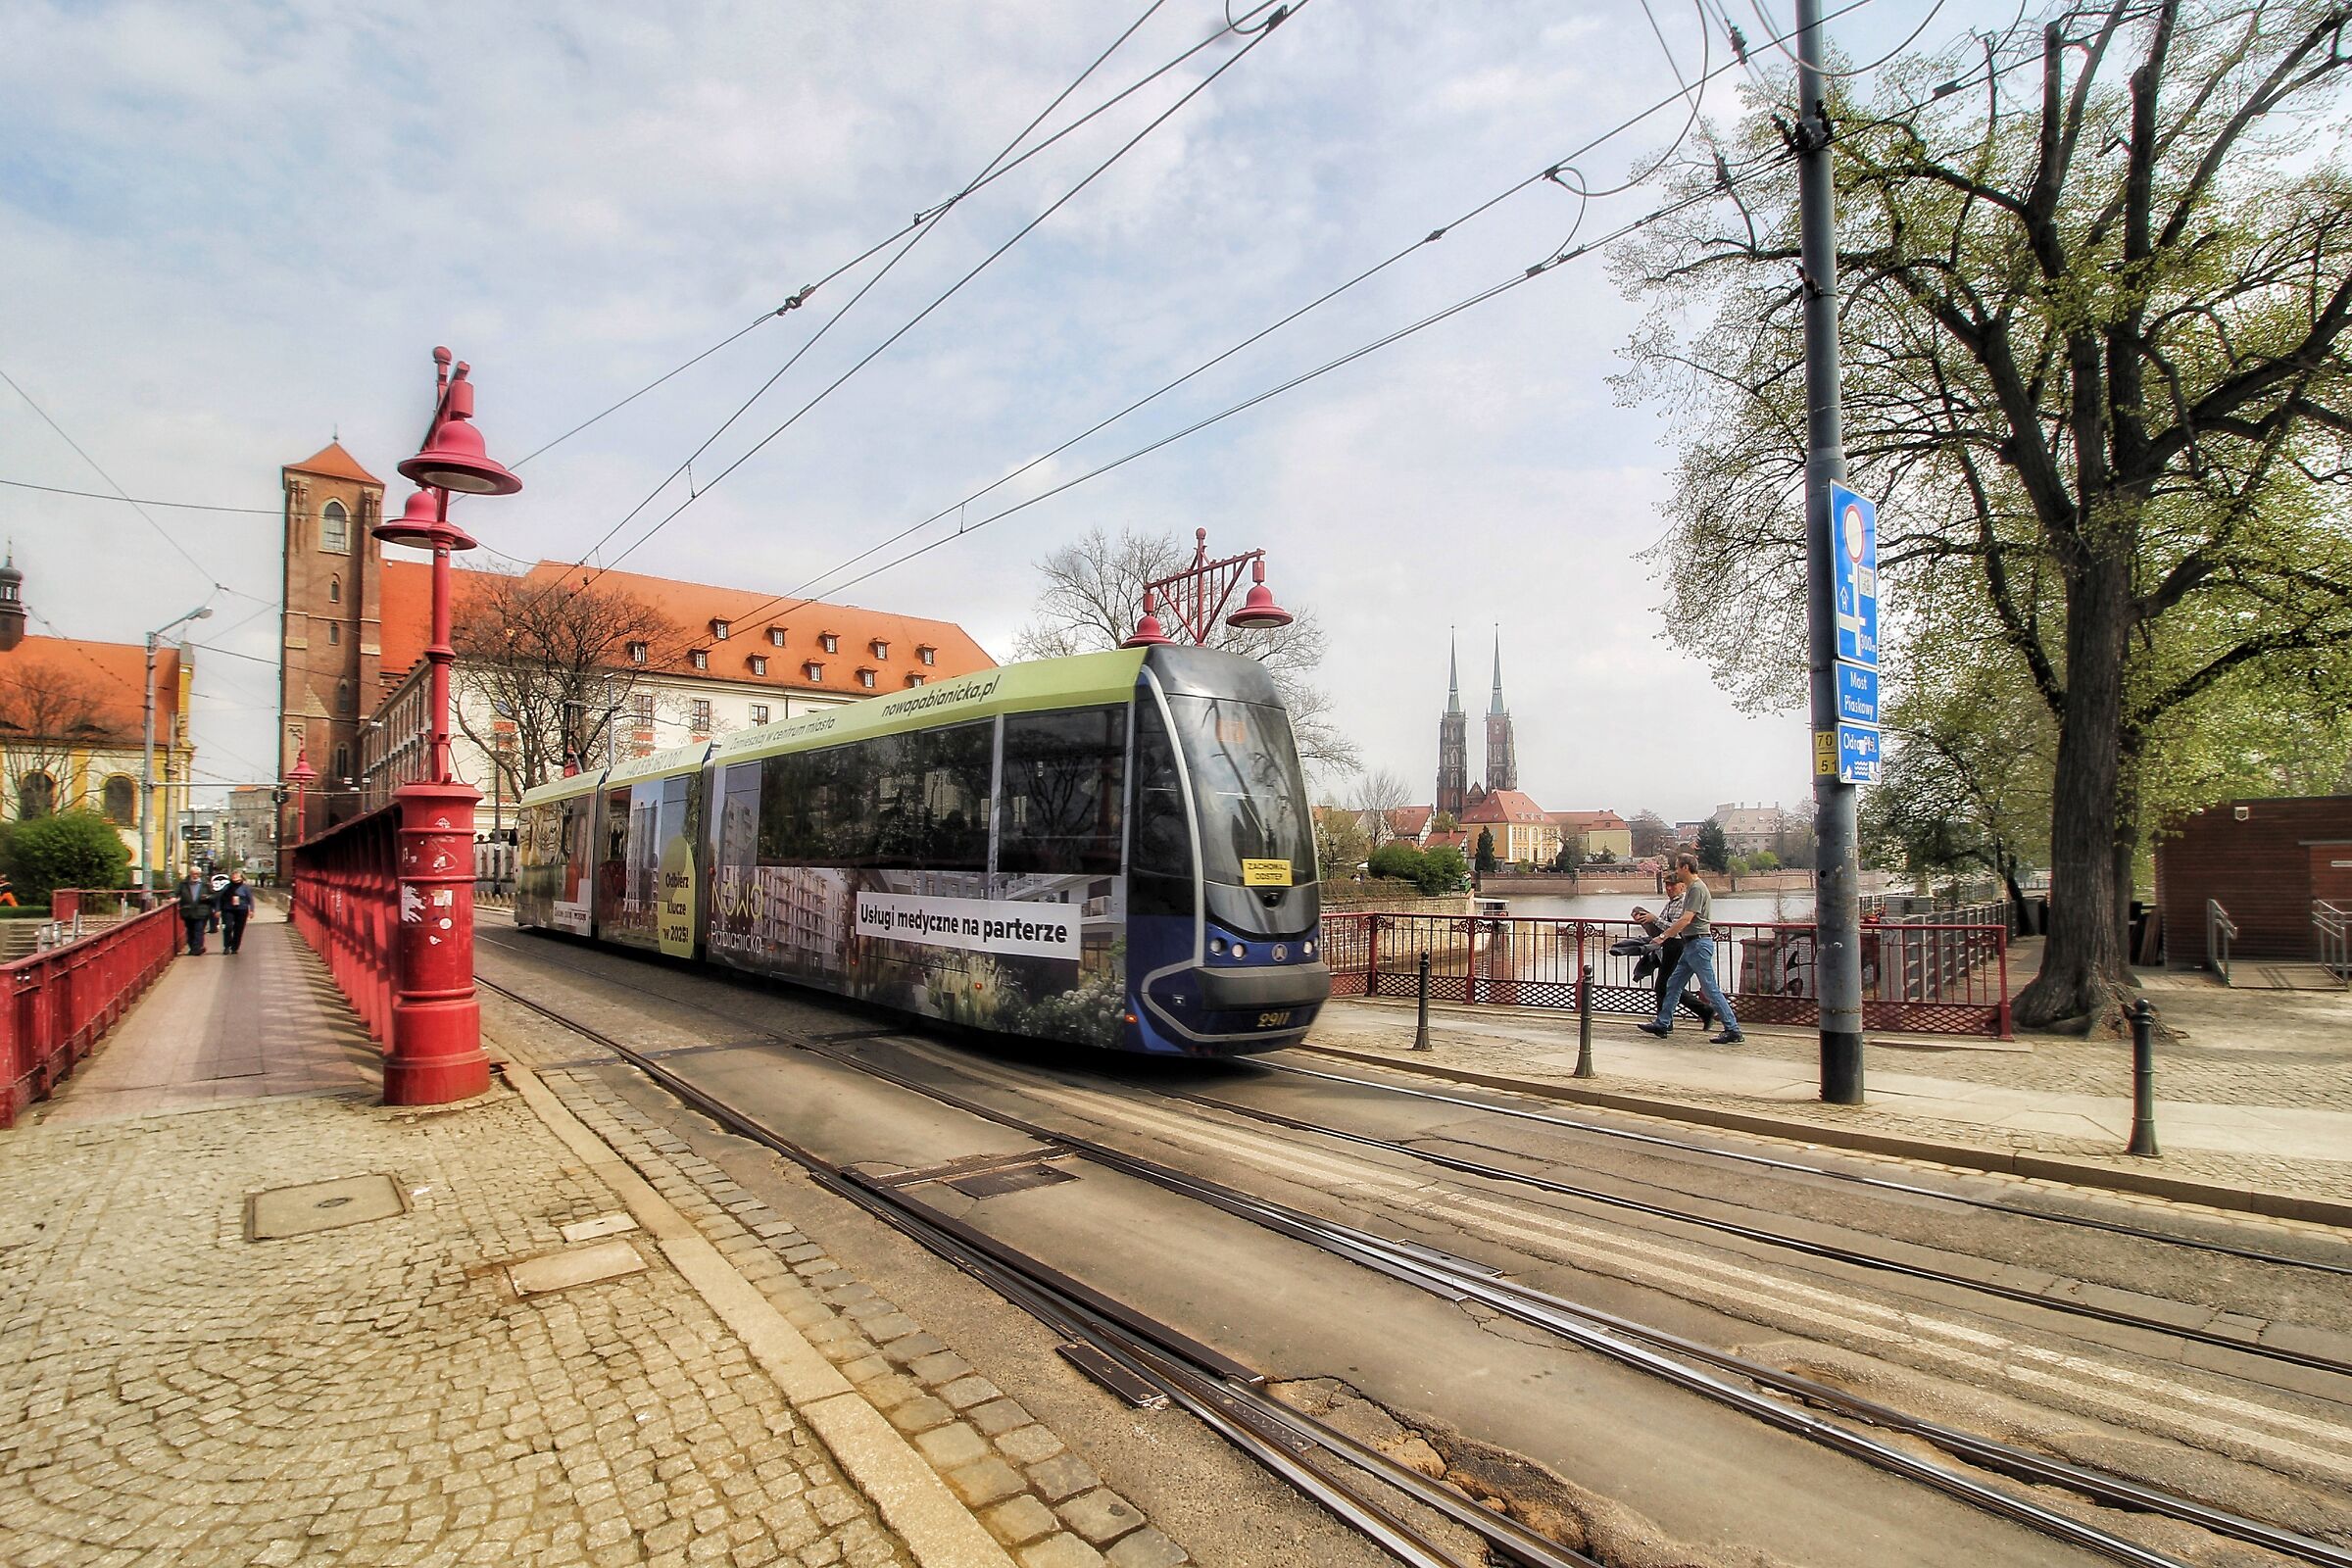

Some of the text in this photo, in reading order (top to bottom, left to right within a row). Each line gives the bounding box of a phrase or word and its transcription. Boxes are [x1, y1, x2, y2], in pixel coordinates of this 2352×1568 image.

[1850, 671, 1868, 690] Most
[882, 674, 1001, 717] nowapabianicka.pl
[1844, 695, 1874, 720] Piaskowy
[772, 724, 806, 740] centrum
[805, 716, 836, 733] miasta
[1817, 734, 1833, 747] 70
[666, 872, 689, 888] Odbierz
[666, 902, 686, 915] klucze
[860, 904, 1067, 944] Usługi medyczne na parterze
[662, 925, 689, 943] w 2025!
[710, 921, 762, 954] Pabianicka
[1256, 1010, 1291, 1027] 2911
